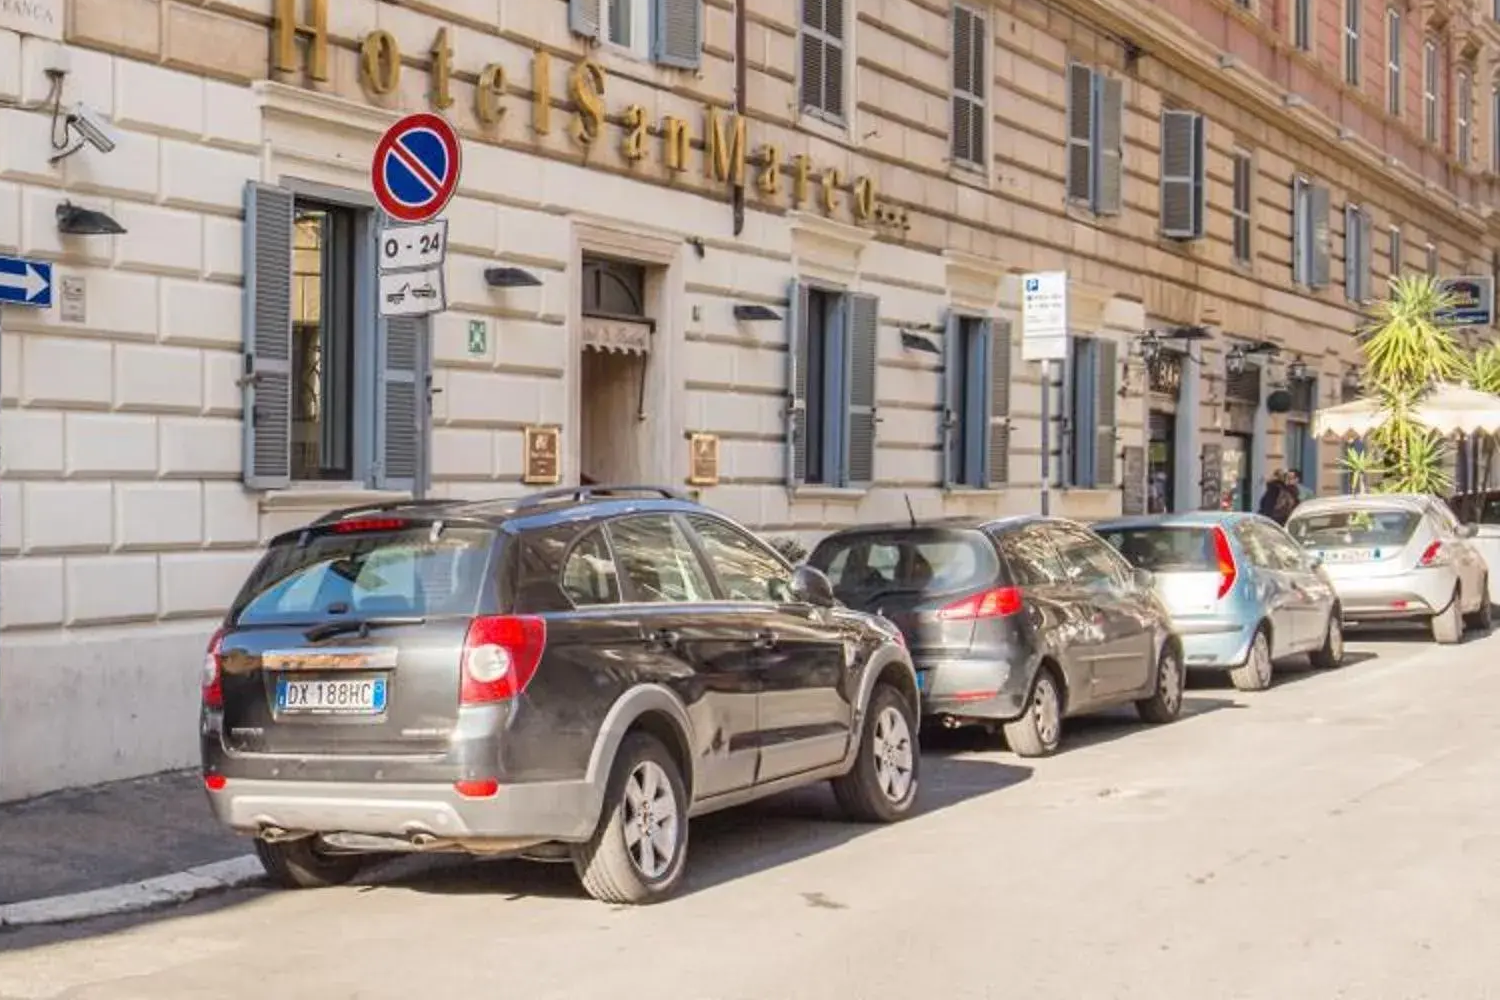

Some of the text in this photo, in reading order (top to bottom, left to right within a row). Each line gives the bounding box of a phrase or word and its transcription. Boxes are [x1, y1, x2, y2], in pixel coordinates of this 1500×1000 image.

[419, 232, 440, 255] 24
[288, 683, 371, 705] DX 188HC
